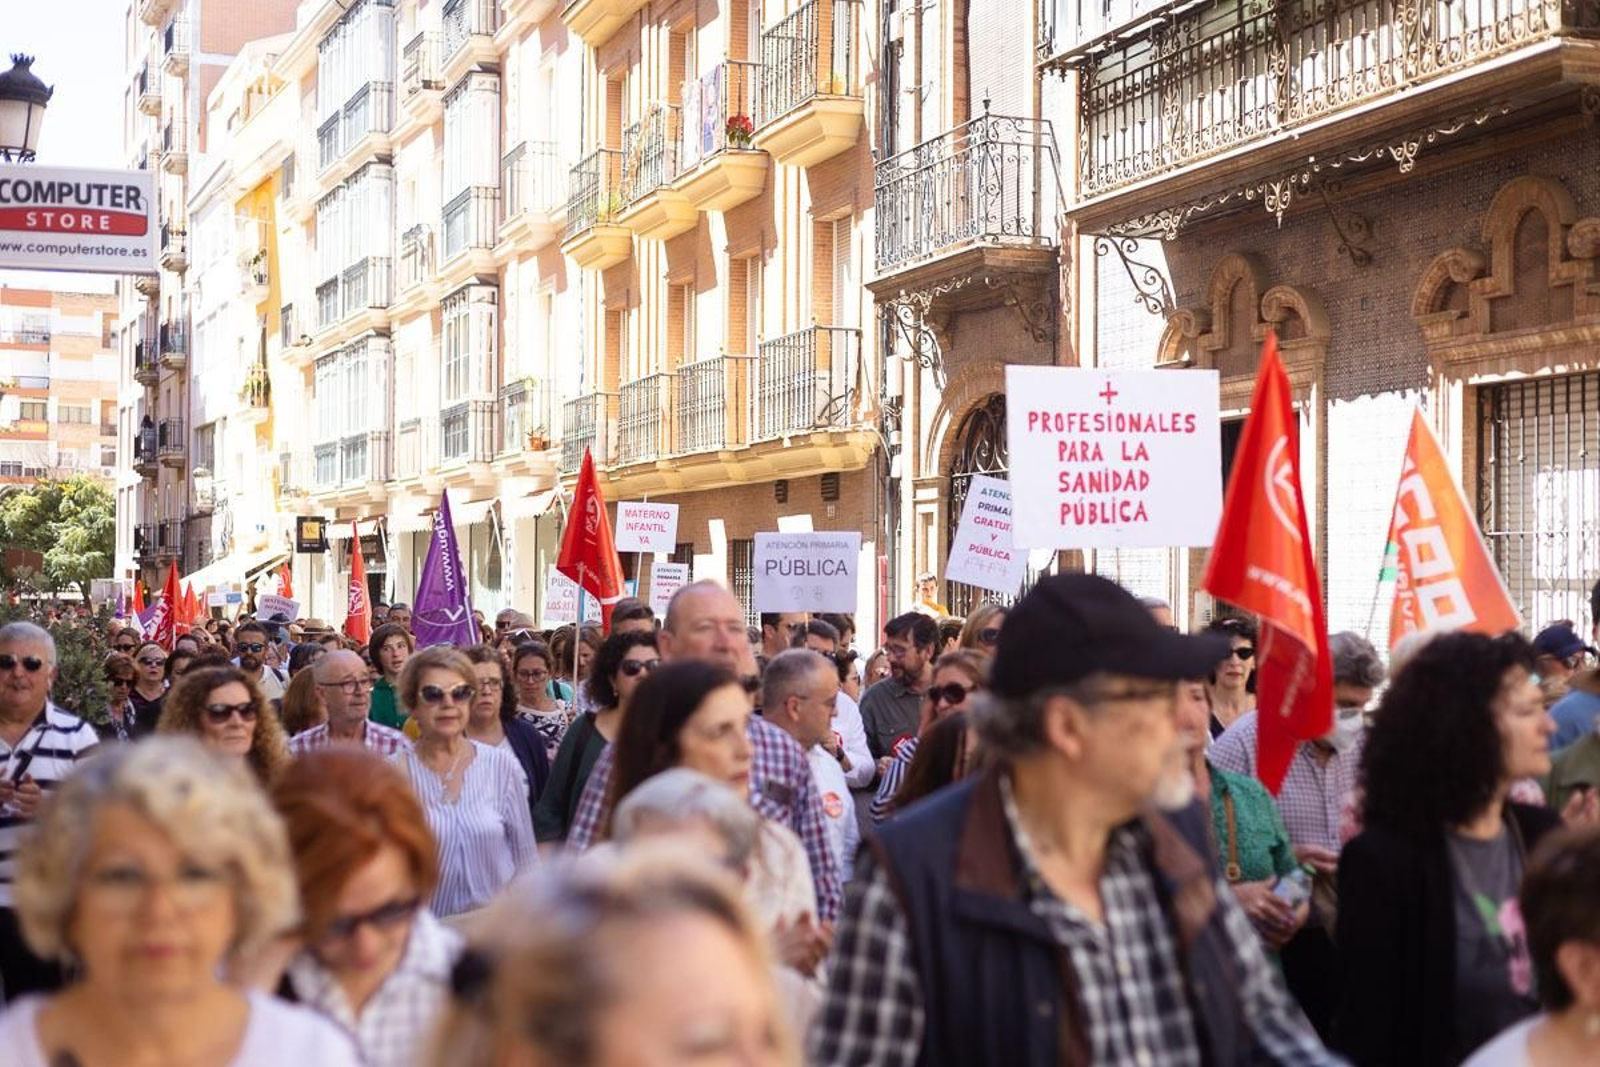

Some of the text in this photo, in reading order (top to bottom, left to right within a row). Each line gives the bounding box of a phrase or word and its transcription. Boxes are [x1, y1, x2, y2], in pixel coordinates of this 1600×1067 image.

[0, 179, 141, 210] COMPUTER
[26, 212, 111, 230] STORE
[1028, 411, 1196, 433] PROFESIONALES
[1058, 441, 1149, 462] PARA LA
[1058, 468, 1150, 493] SANIDAD
[980, 487, 1012, 501] ATENC
[624, 508, 671, 521] MATERNO
[977, 501, 1012, 516] PRIMA
[1060, 496, 1148, 525] PÚBLICA
[625, 521, 667, 533] INFANTIL
[638, 535, 650, 544] YA
[765, 540, 849, 550] ATENCIÓN PRIMARIA
[1395, 455, 1479, 629] COO
[764, 555, 849, 576] PÚBLICA
